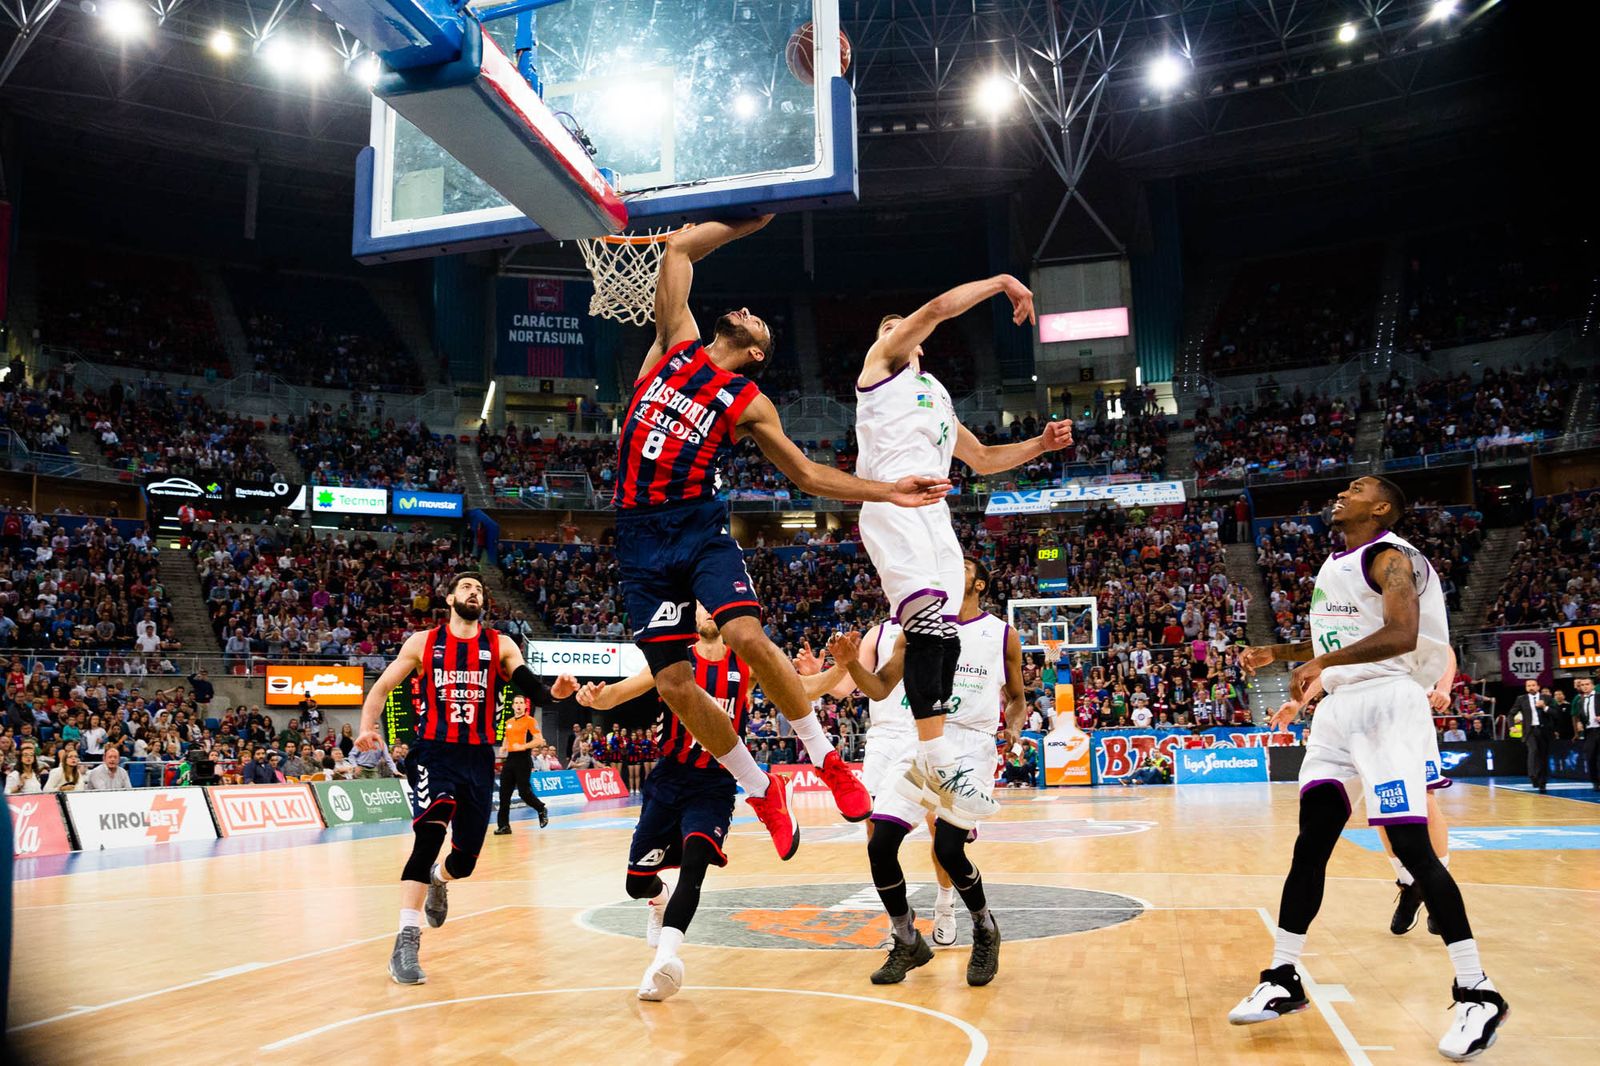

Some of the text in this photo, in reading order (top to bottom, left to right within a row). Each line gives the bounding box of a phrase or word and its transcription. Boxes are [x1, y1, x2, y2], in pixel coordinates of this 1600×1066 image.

[513, 312, 580, 329] CARÁCTER
[508, 330, 584, 345] NORTASUNA
[641, 430, 667, 460] 8
[340, 495, 385, 507] Tecman
[418, 500, 457, 510] movistar
[1326, 601, 1360, 615] Unicaja
[1318, 630, 1342, 653] 15
[531, 651, 611, 665] EL CORREO
[1514, 646, 1536, 658] OLD
[1512, 662, 1542, 673] STYLE
[450, 702, 475, 725] 23
[541, 776, 564, 791] ASPY
[359, 787, 402, 806] befree
[230, 798, 309, 826] VIALKI
